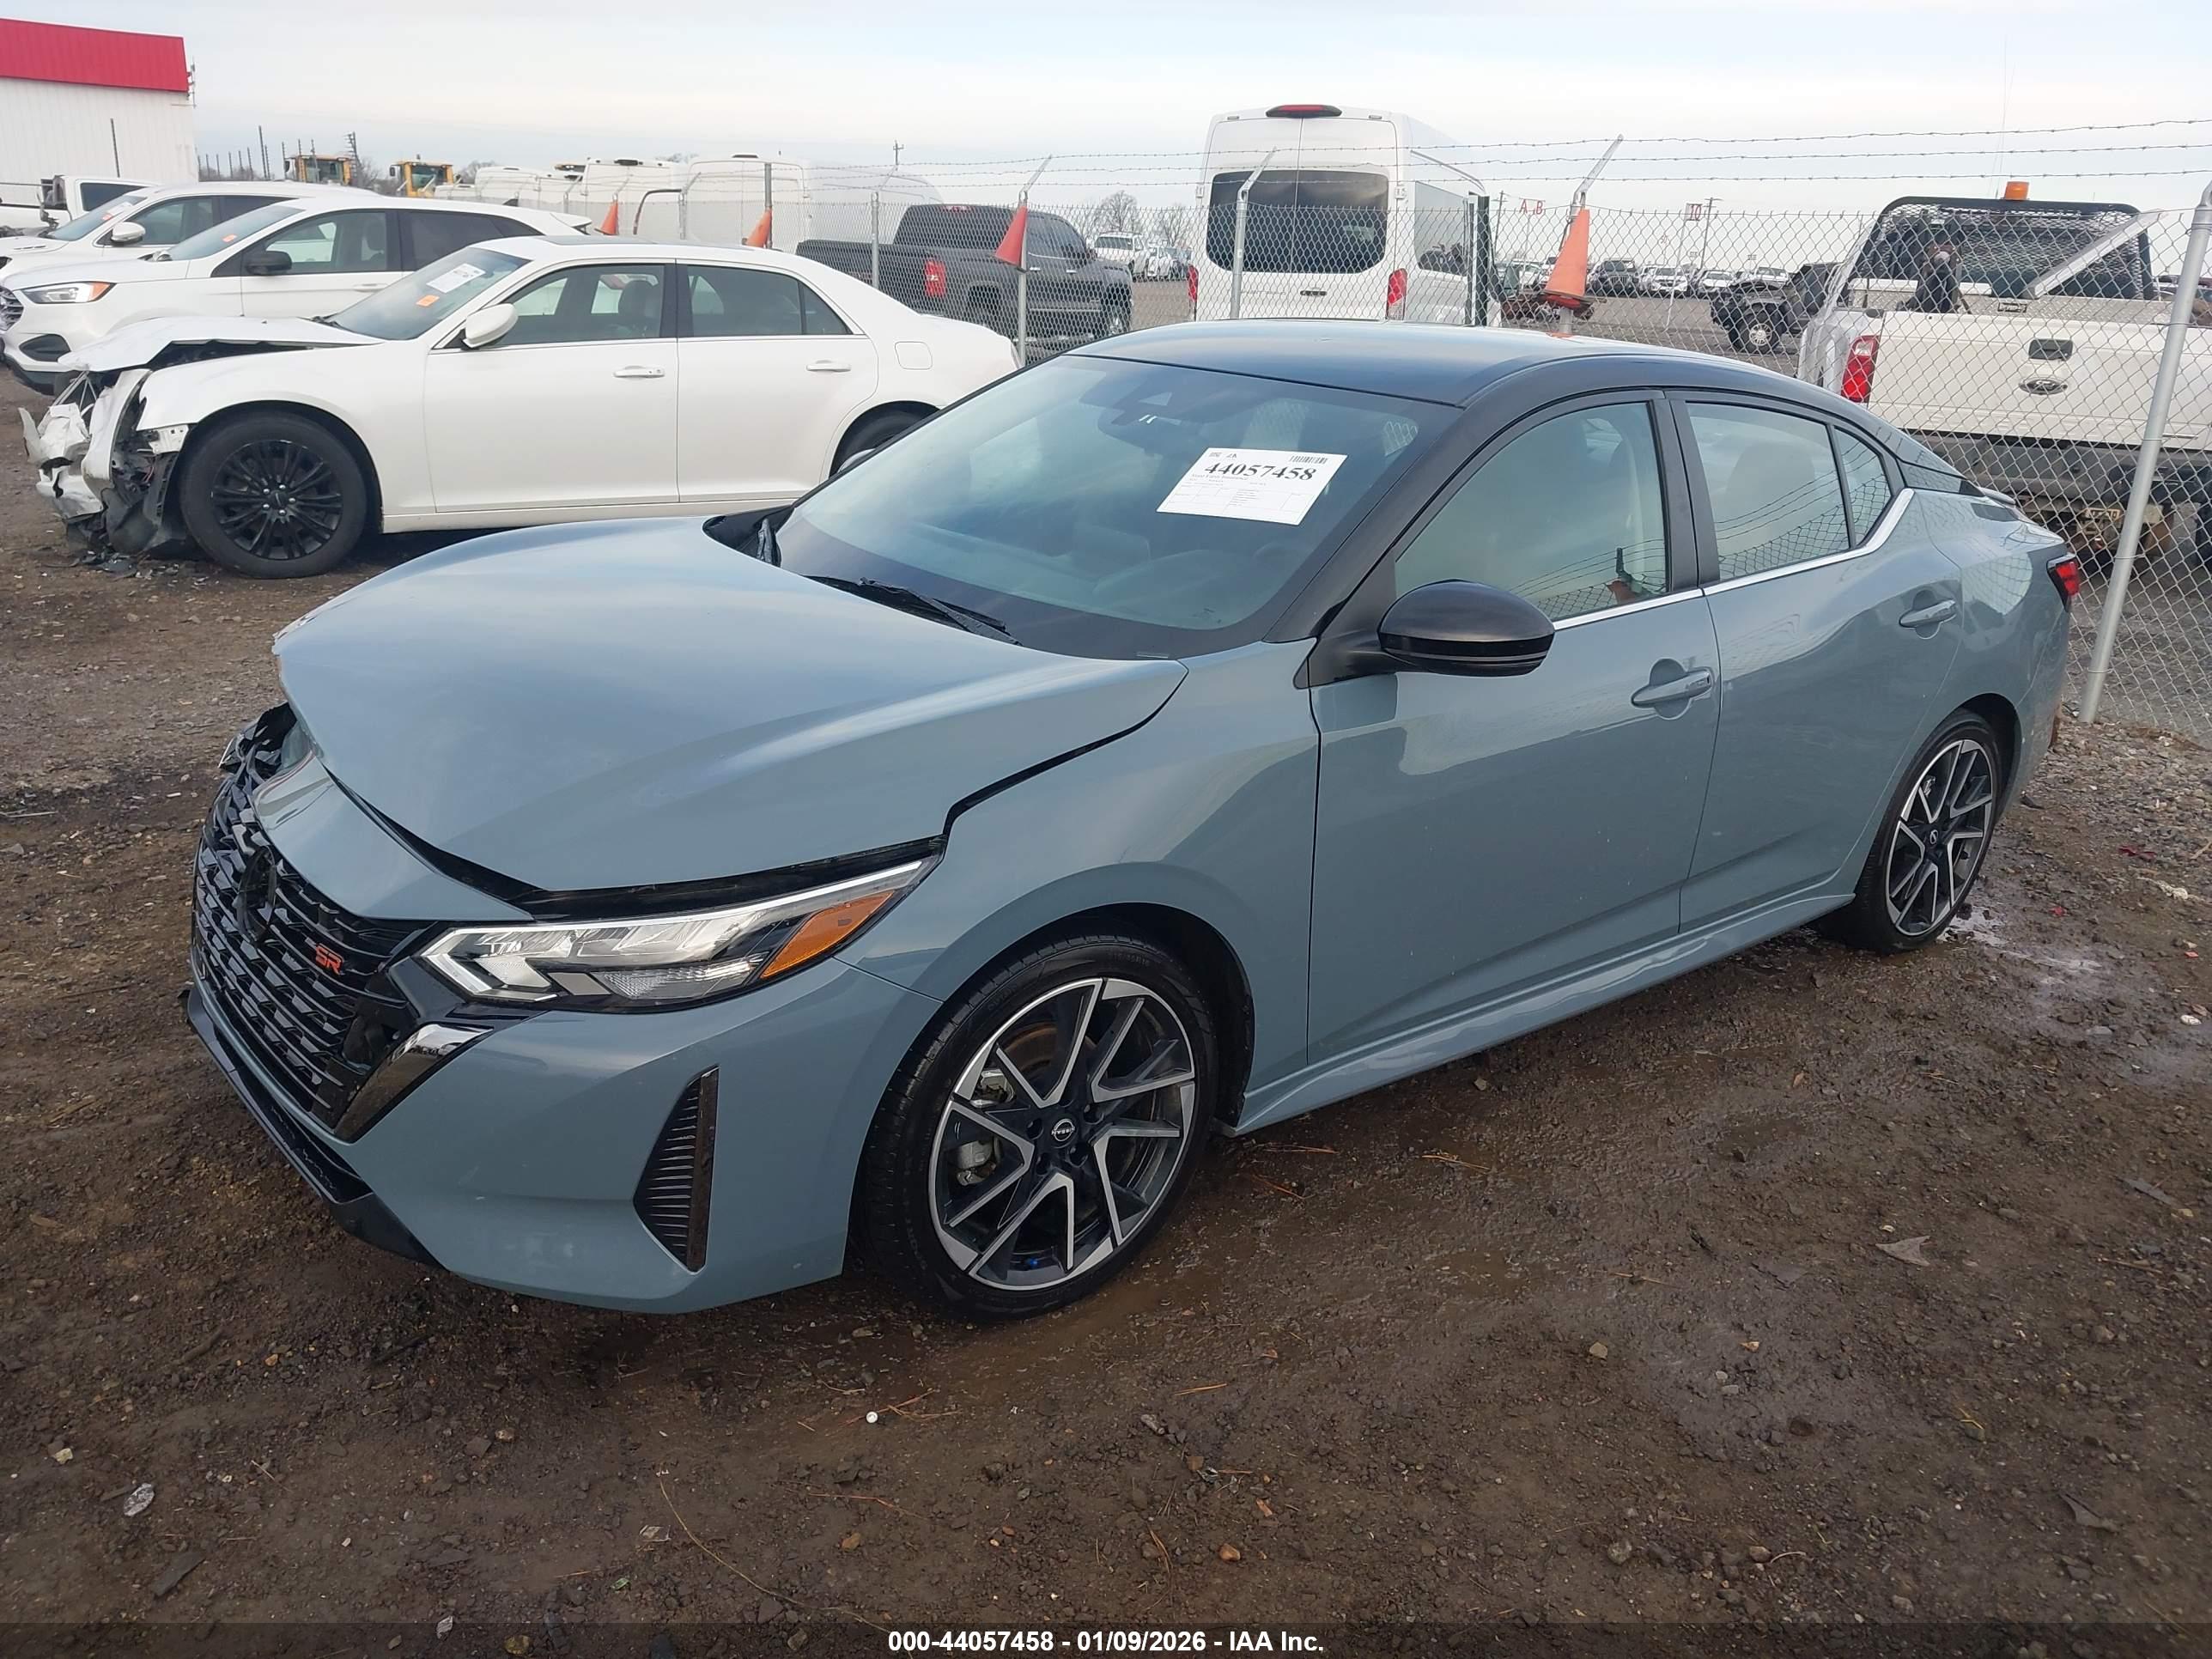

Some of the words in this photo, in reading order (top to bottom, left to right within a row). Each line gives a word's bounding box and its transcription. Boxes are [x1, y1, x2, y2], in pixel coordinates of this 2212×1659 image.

[1519, 198, 1528, 214] A
[1536, 200, 1543, 215] B
[1205, 462, 1317, 481] 44057458
[315, 945, 342, 975] SR
